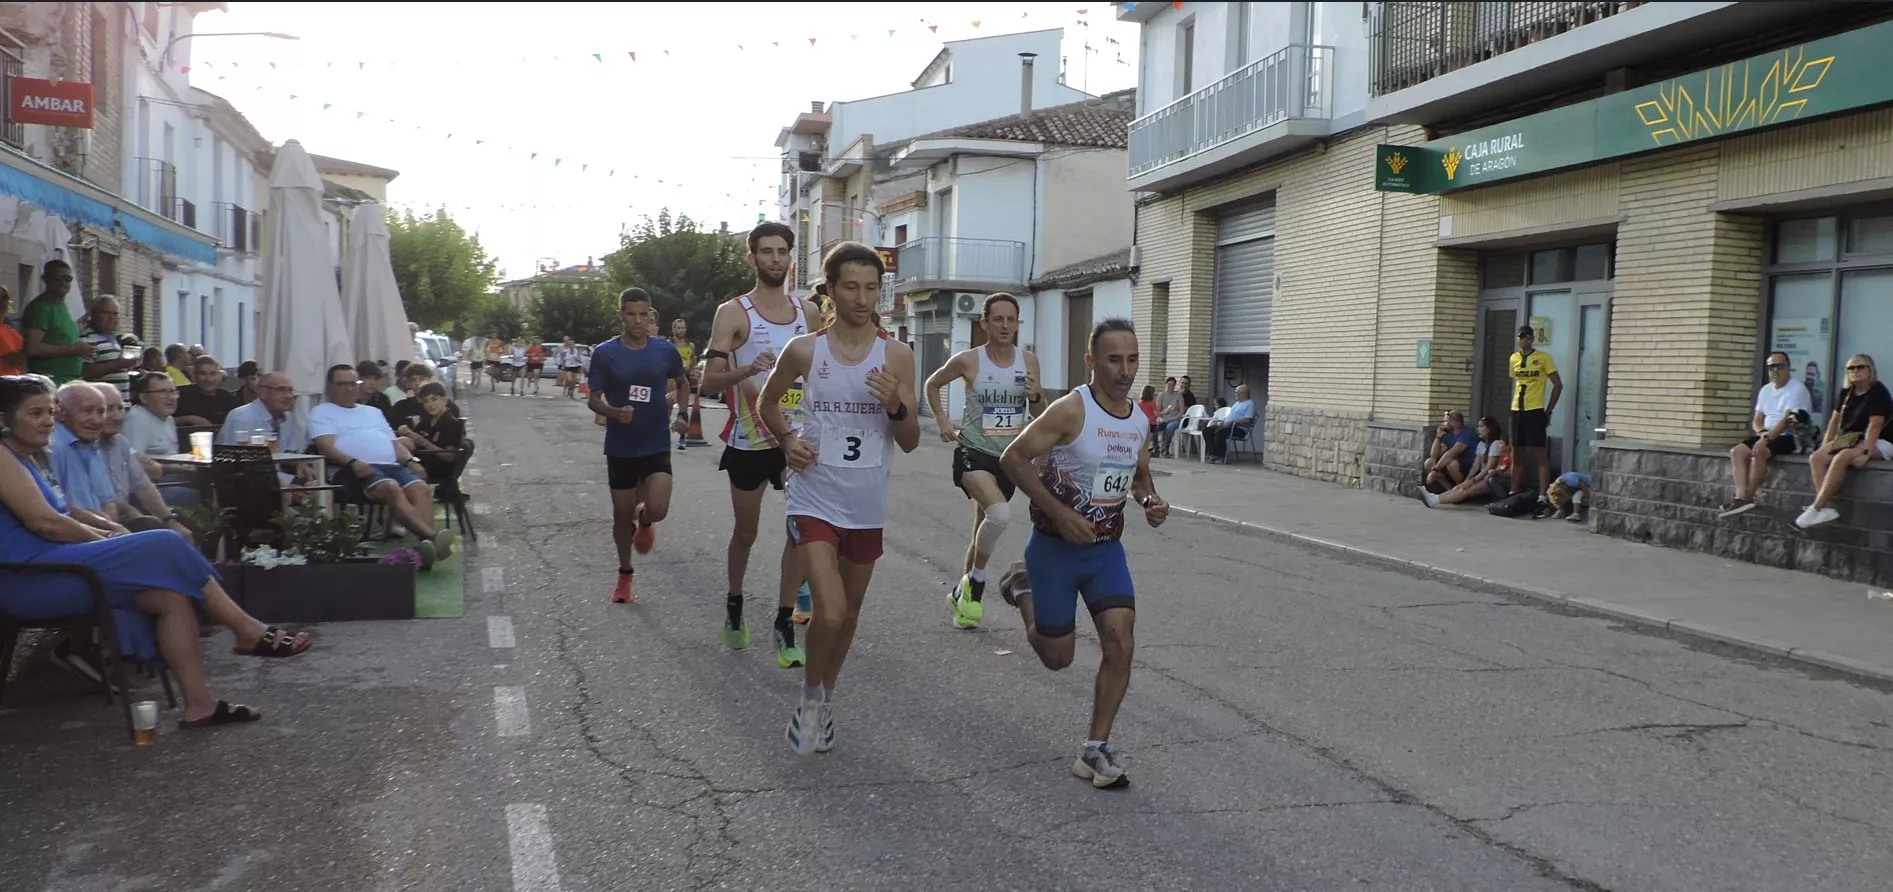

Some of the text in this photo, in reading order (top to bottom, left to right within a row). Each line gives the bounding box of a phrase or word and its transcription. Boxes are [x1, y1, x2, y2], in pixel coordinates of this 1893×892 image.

[21, 95, 86, 113] AMBAR
[1464, 133, 1524, 160] CAJA RURAL
[1469, 162, 1481, 176] DE
[629, 387, 649, 401] 49
[781, 391, 801, 404] 312
[995, 415, 1013, 428] 21
[843, 436, 862, 461] 3
[1104, 475, 1129, 493] 642
